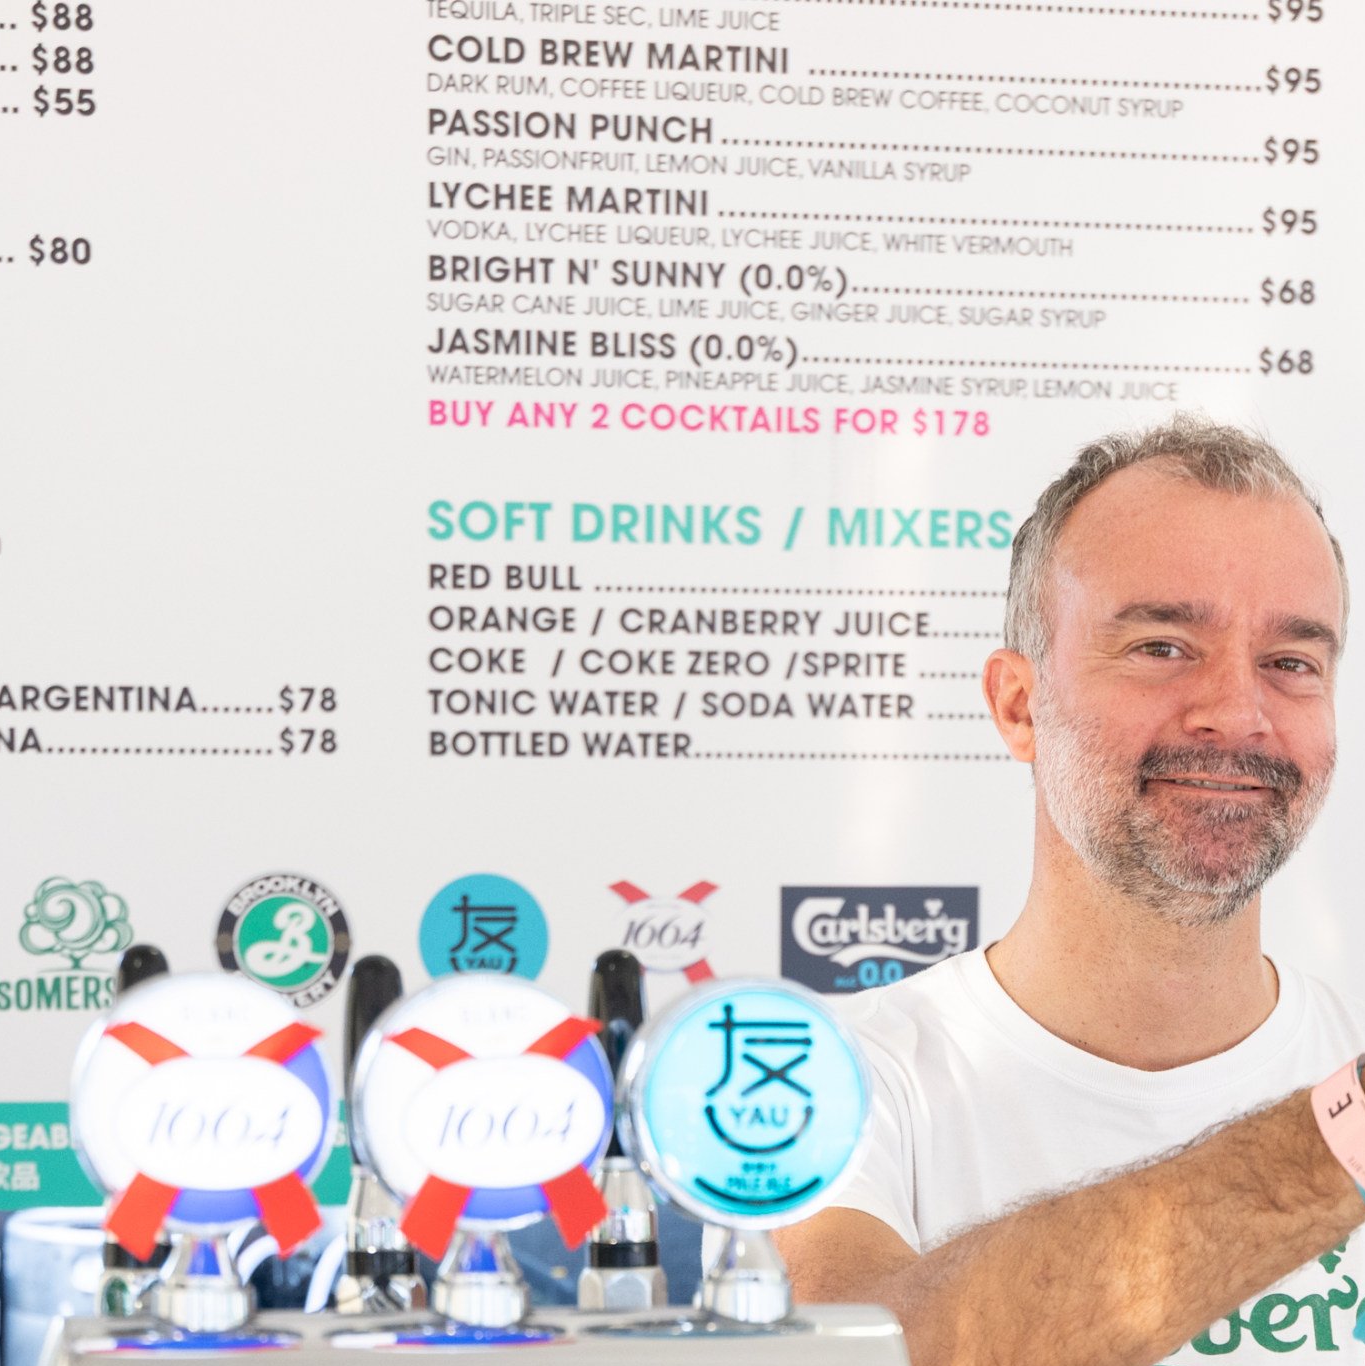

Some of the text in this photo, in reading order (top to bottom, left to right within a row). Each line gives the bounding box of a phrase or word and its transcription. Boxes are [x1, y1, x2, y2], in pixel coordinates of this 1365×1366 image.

[32, 0, 93, 32] $88
[426, 0, 779, 31] TEQUILA, TRIPLE SEC, LIME JUICE
[1268, 0, 1323, 23] $95
[32, 43, 94, 75] $88
[427, 34, 1321, 94] COLD BREW MARTINI $95
[34, 85, 96, 117] $55
[427, 72, 1184, 118] DARK RUM, COFFEE LIQUEUR, COLD BREW COFFEE, COCONUT SYRUP
[429, 108, 1319, 165] PASSION PUNCH $95
[427, 146, 971, 182] GIN, PASSIONFRUIT, LEMON JUICE, VANILLA SYRUP
[429, 182, 1317, 235] LYCHEE MARTINI $95
[29, 234, 91, 266] $80
[427, 220, 1073, 257] VODKA, LYCHEE LIQUEUR, LYCHEE JUICE, WHITE VERMOUTH
[429, 255, 1315, 305] BRIGHT N' SUNNY (0.0%) $68
[427, 292, 1106, 328] SUGAR CANE JUICE, LIME JUICE, GINGER JUICE, SUGAR SYRUP
[427, 328, 1314, 375] JASMINE BLISS (0.0%) $68
[427, 365, 1177, 401] WATERMELON JUICE, PINEAPPLE JUICE, JASMINE LEMON JUICE
[429, 400, 990, 437] BUY ANY 2 COCKTAILS FOR $178
[428, 500, 1011, 549] SOFT DRINKS MIXERS
[429, 564, 581, 591] RED BULL
[428, 605, 575, 633] ORANGE
[619, 608, 821, 635] CRANBERRY
[428, 647, 525, 674] COKE
[579, 649, 674, 675] COKE
[688, 650, 770, 676] ZERO
[280, 685, 337, 714] $78
[428, 689, 914, 718] TONIC WATER SODA WATER
[280, 727, 337, 756] $78
[430, 731, 569, 757] BOTTLED
[227, 874, 339, 916] BROOKLYN
[623, 918, 707, 950] 1664
[792, 897, 970, 965] Carlsberg
[729, 1107, 789, 1127] YAU
